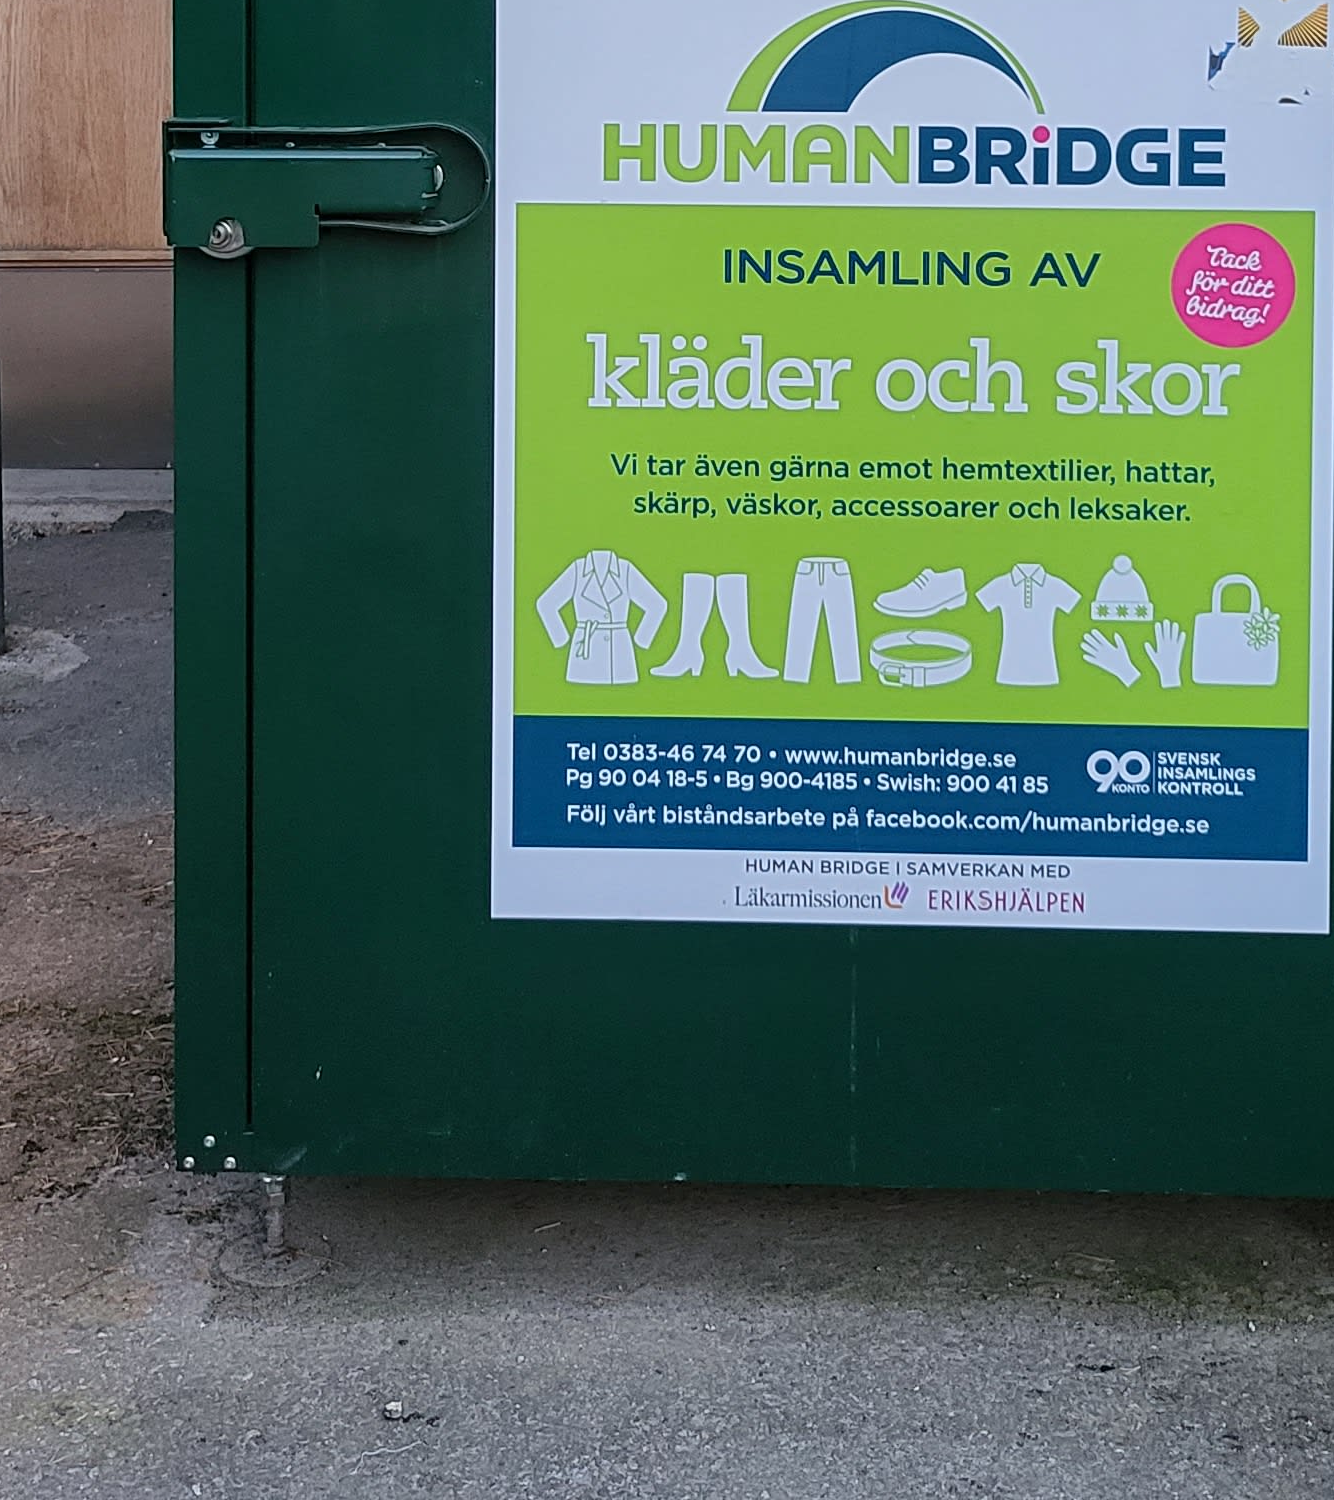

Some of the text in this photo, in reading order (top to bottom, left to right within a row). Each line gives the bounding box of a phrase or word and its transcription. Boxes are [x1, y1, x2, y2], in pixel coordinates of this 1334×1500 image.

[722, 248, 1102, 288] INSAMLING AV
[1207, 245, 1262, 272] Tack
[1186, 270, 1275, 299] för ditt
[1185, 295, 1271, 329] bidrag!
[586, 332, 1241, 416] kläder och skor
[610, 453, 1215, 488] Vi tar även gärna emot hemtextilier, hattar,
[633, 490, 1191, 522] skärp, väskor, accessoarer och leksaker.
[567, 743, 1017, 771] Tel 0383-46 74 70 www.humanbridge.se
[1156, 751, 1221, 767] SVENSK
[567, 769, 1049, 795] Pg 90 04 18-5 Bg 900-4185 Swish: 900 41 85
[1086, 749, 1151, 795] 90 KONTO
[1156, 766, 1257, 783] INSAMLINGS
[1156, 781, 1244, 797] KONTROLL
[567, 803, 1210, 838] Följ vårt biståndsarbete på facebook.com/humanbridge.se
[745, 858, 1071, 879] HUMAN BRIDGE I SAMVERKAN MED
[735, 885, 882, 909] Läkarmissionen
[928, 887, 1086, 914] ERIKSHJÄLPEN
